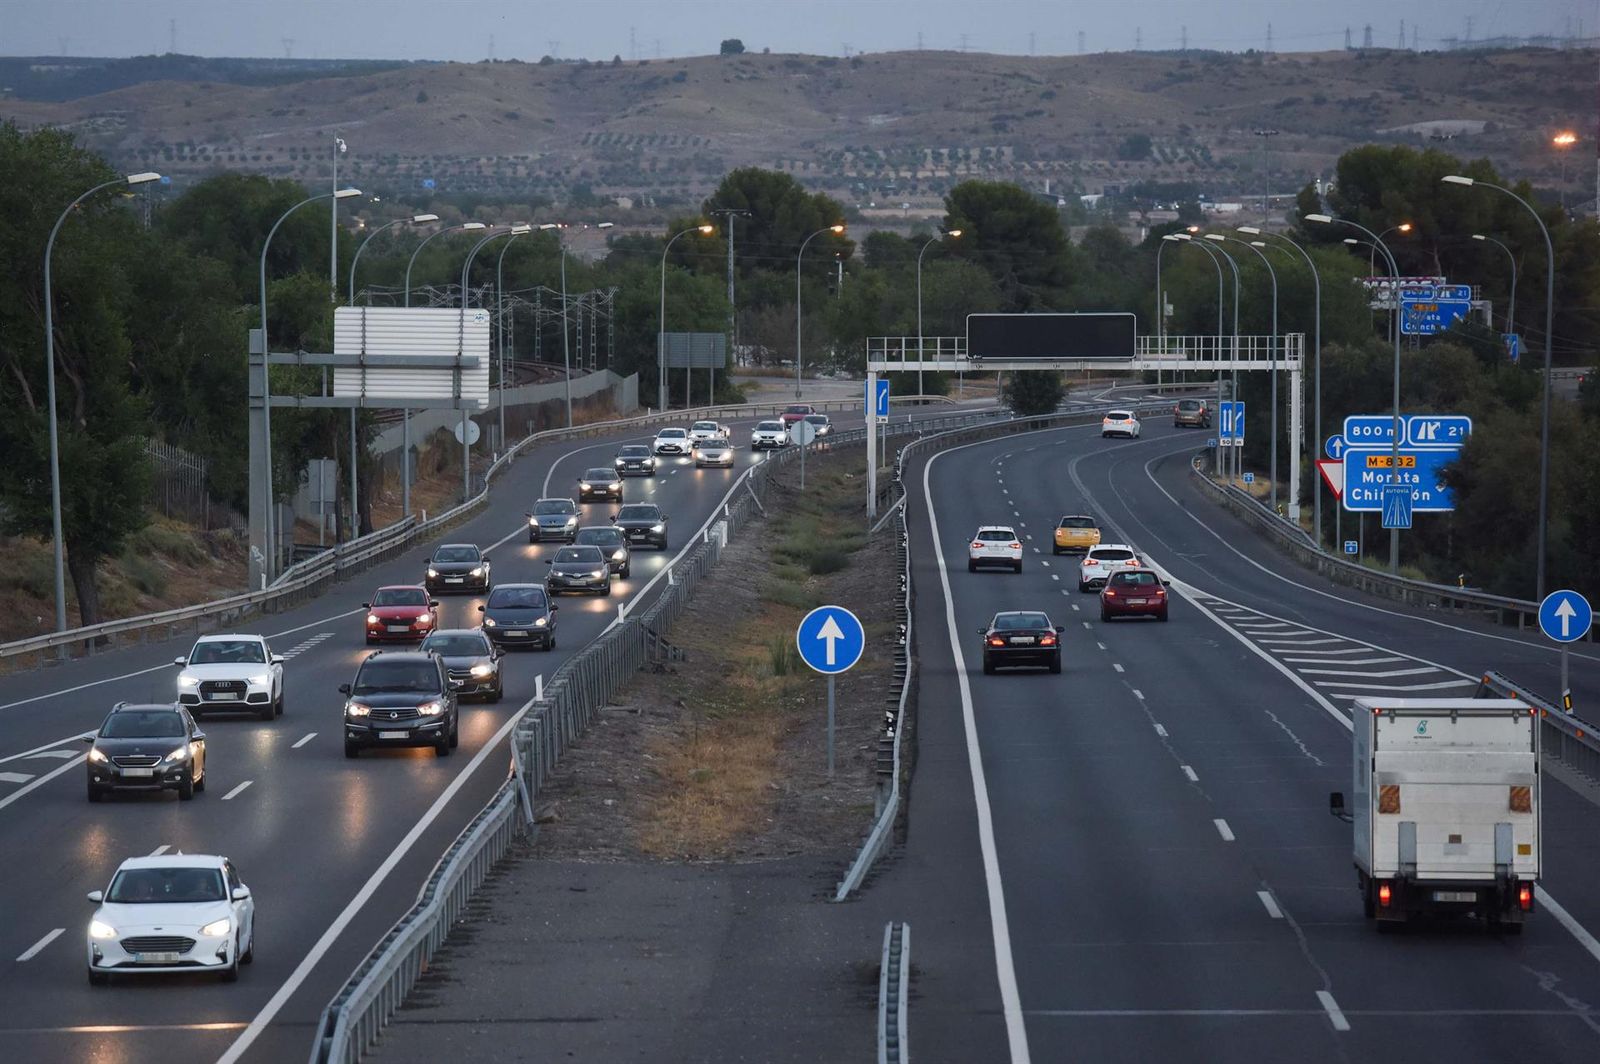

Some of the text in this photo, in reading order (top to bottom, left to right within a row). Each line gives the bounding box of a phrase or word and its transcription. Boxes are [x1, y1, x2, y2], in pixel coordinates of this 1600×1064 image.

[1352, 426, 1383, 436] 800
[1448, 427, 1464, 436] 21
[1368, 457, 1414, 467] M-832
[1352, 488, 1430, 501] Chión
